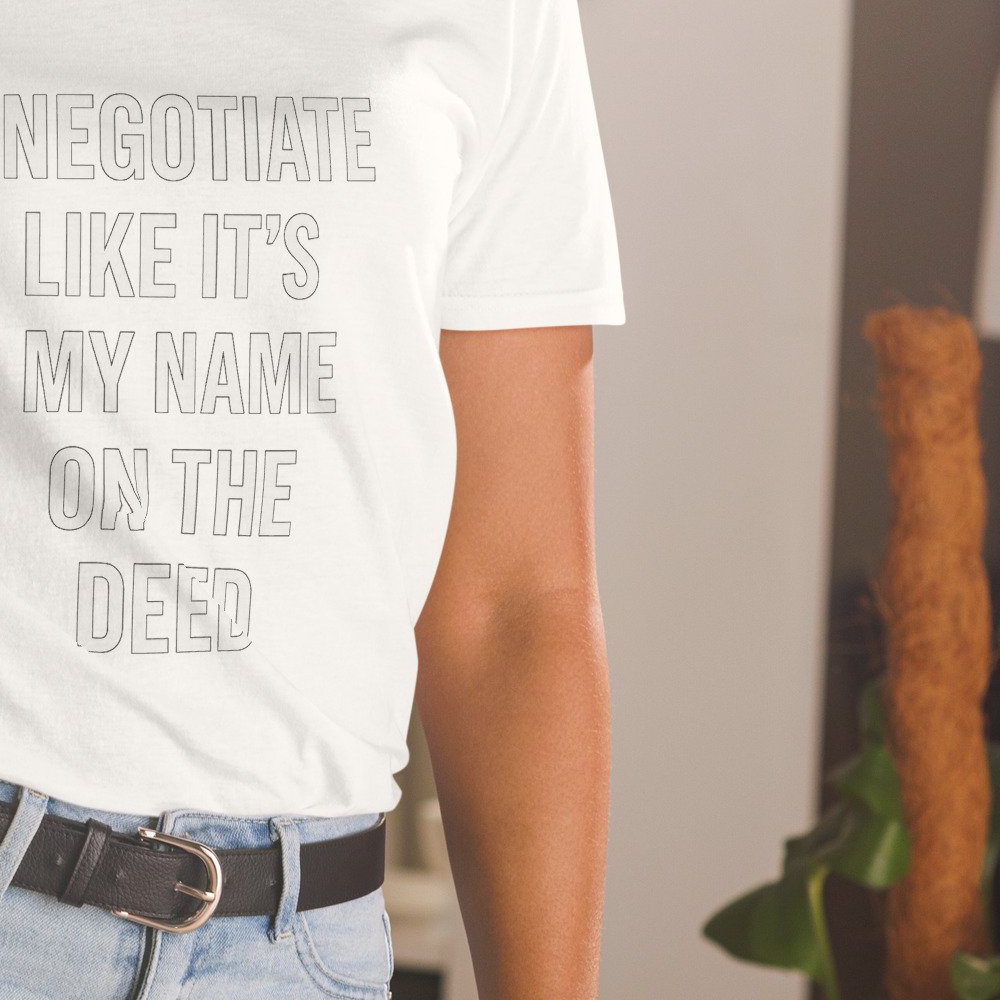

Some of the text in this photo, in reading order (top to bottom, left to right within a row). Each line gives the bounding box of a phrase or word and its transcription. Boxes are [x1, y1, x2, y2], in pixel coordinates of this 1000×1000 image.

[3, 93, 377, 182] NEGOTIATE
[25, 211, 320, 300] LIKE IT’S
[22, 329, 337, 415] MY NAME
[47, 445, 298, 537] ON THE
[76, 561, 253, 655] DEED
